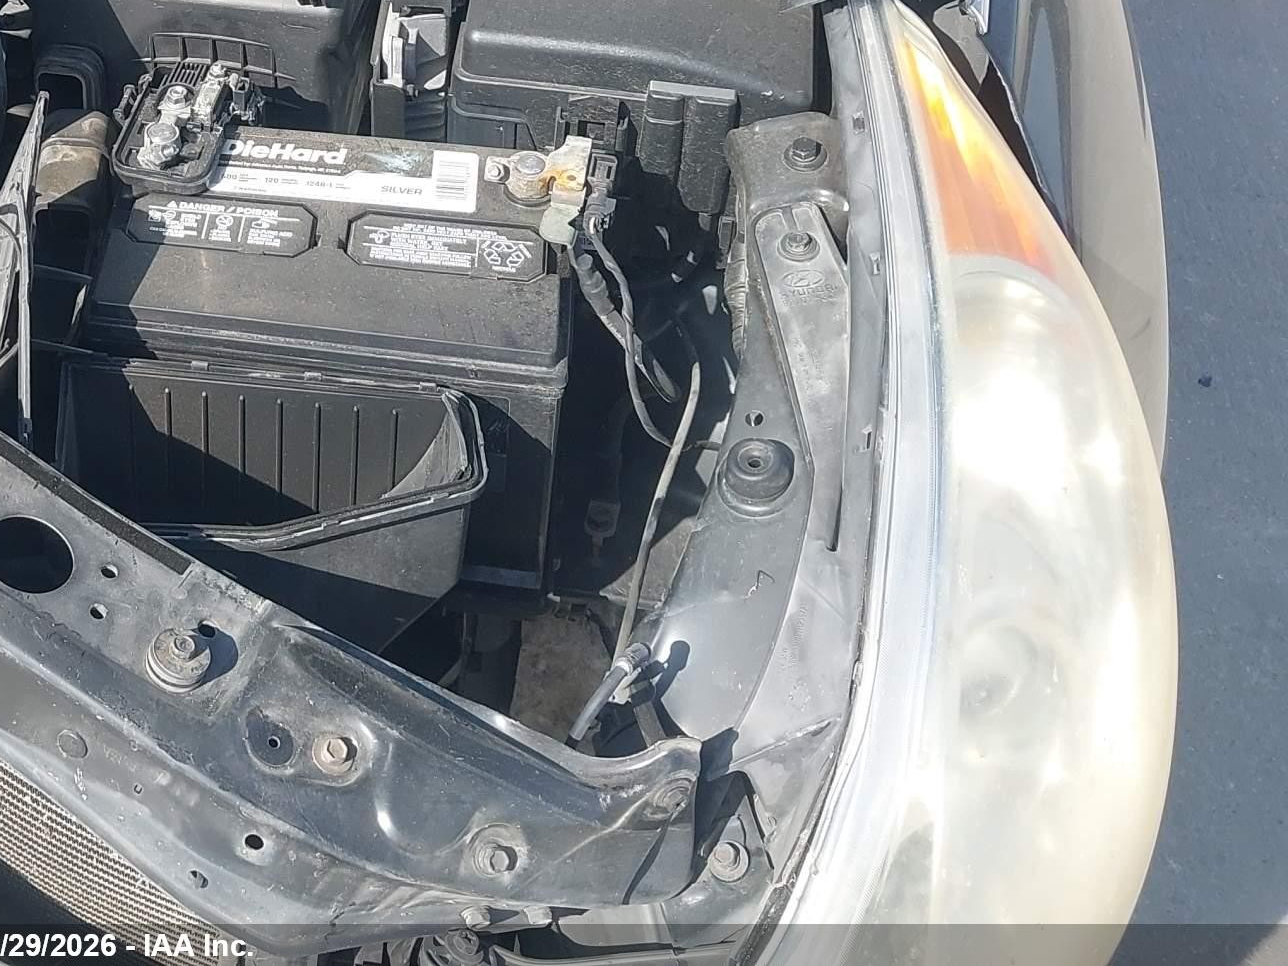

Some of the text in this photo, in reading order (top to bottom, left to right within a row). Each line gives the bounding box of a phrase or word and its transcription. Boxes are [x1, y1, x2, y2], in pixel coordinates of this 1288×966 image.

[221, 139, 348, 166] DieHard
[380, 185, 423, 196] SILVER
[179, 201, 225, 213] DANGER
[236, 206, 279, 218] POISON
